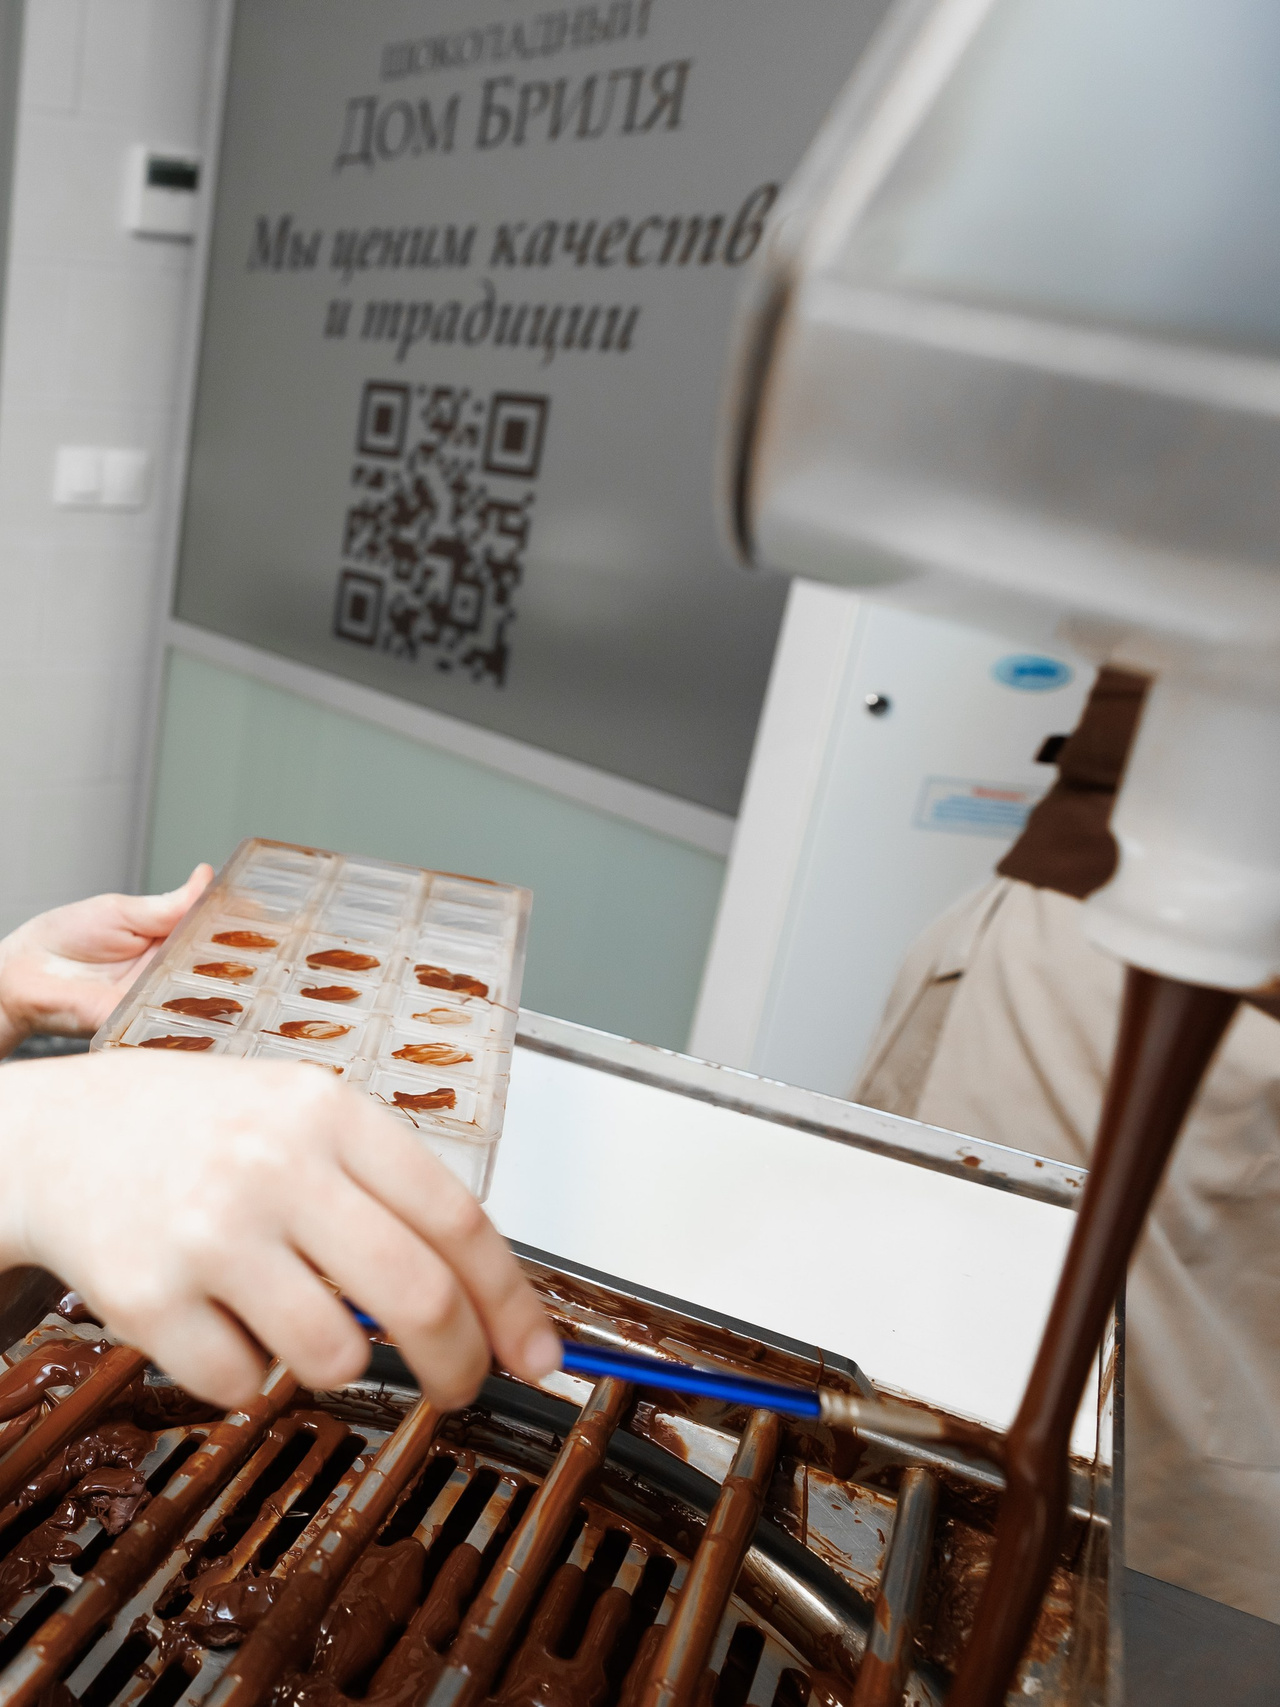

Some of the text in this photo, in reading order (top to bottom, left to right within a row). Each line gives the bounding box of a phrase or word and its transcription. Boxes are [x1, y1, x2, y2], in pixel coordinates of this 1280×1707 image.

[475, 57, 694, 151] БРИЛЯ
[246, 181, 782, 286] Мы ценим качеств
[323, 276, 642, 368] и традиции
